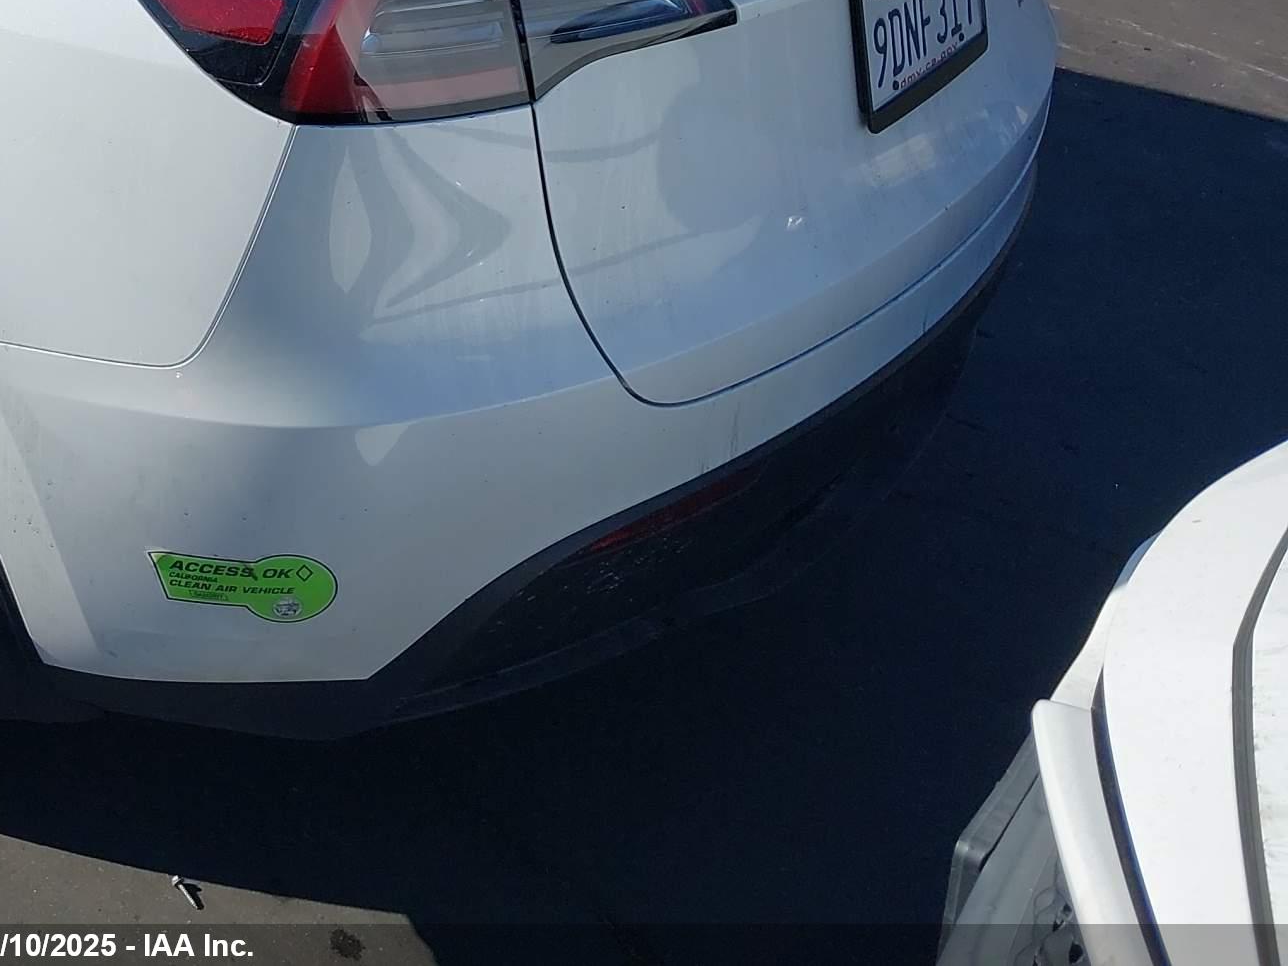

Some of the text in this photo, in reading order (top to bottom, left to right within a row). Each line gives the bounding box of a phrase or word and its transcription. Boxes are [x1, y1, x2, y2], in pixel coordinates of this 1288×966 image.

[168, 571, 218, 583] CALIFORNIA
[169, 560, 294, 579] ACCESS OK
[169, 579, 295, 595] CLEAN AIR VEHICLE
